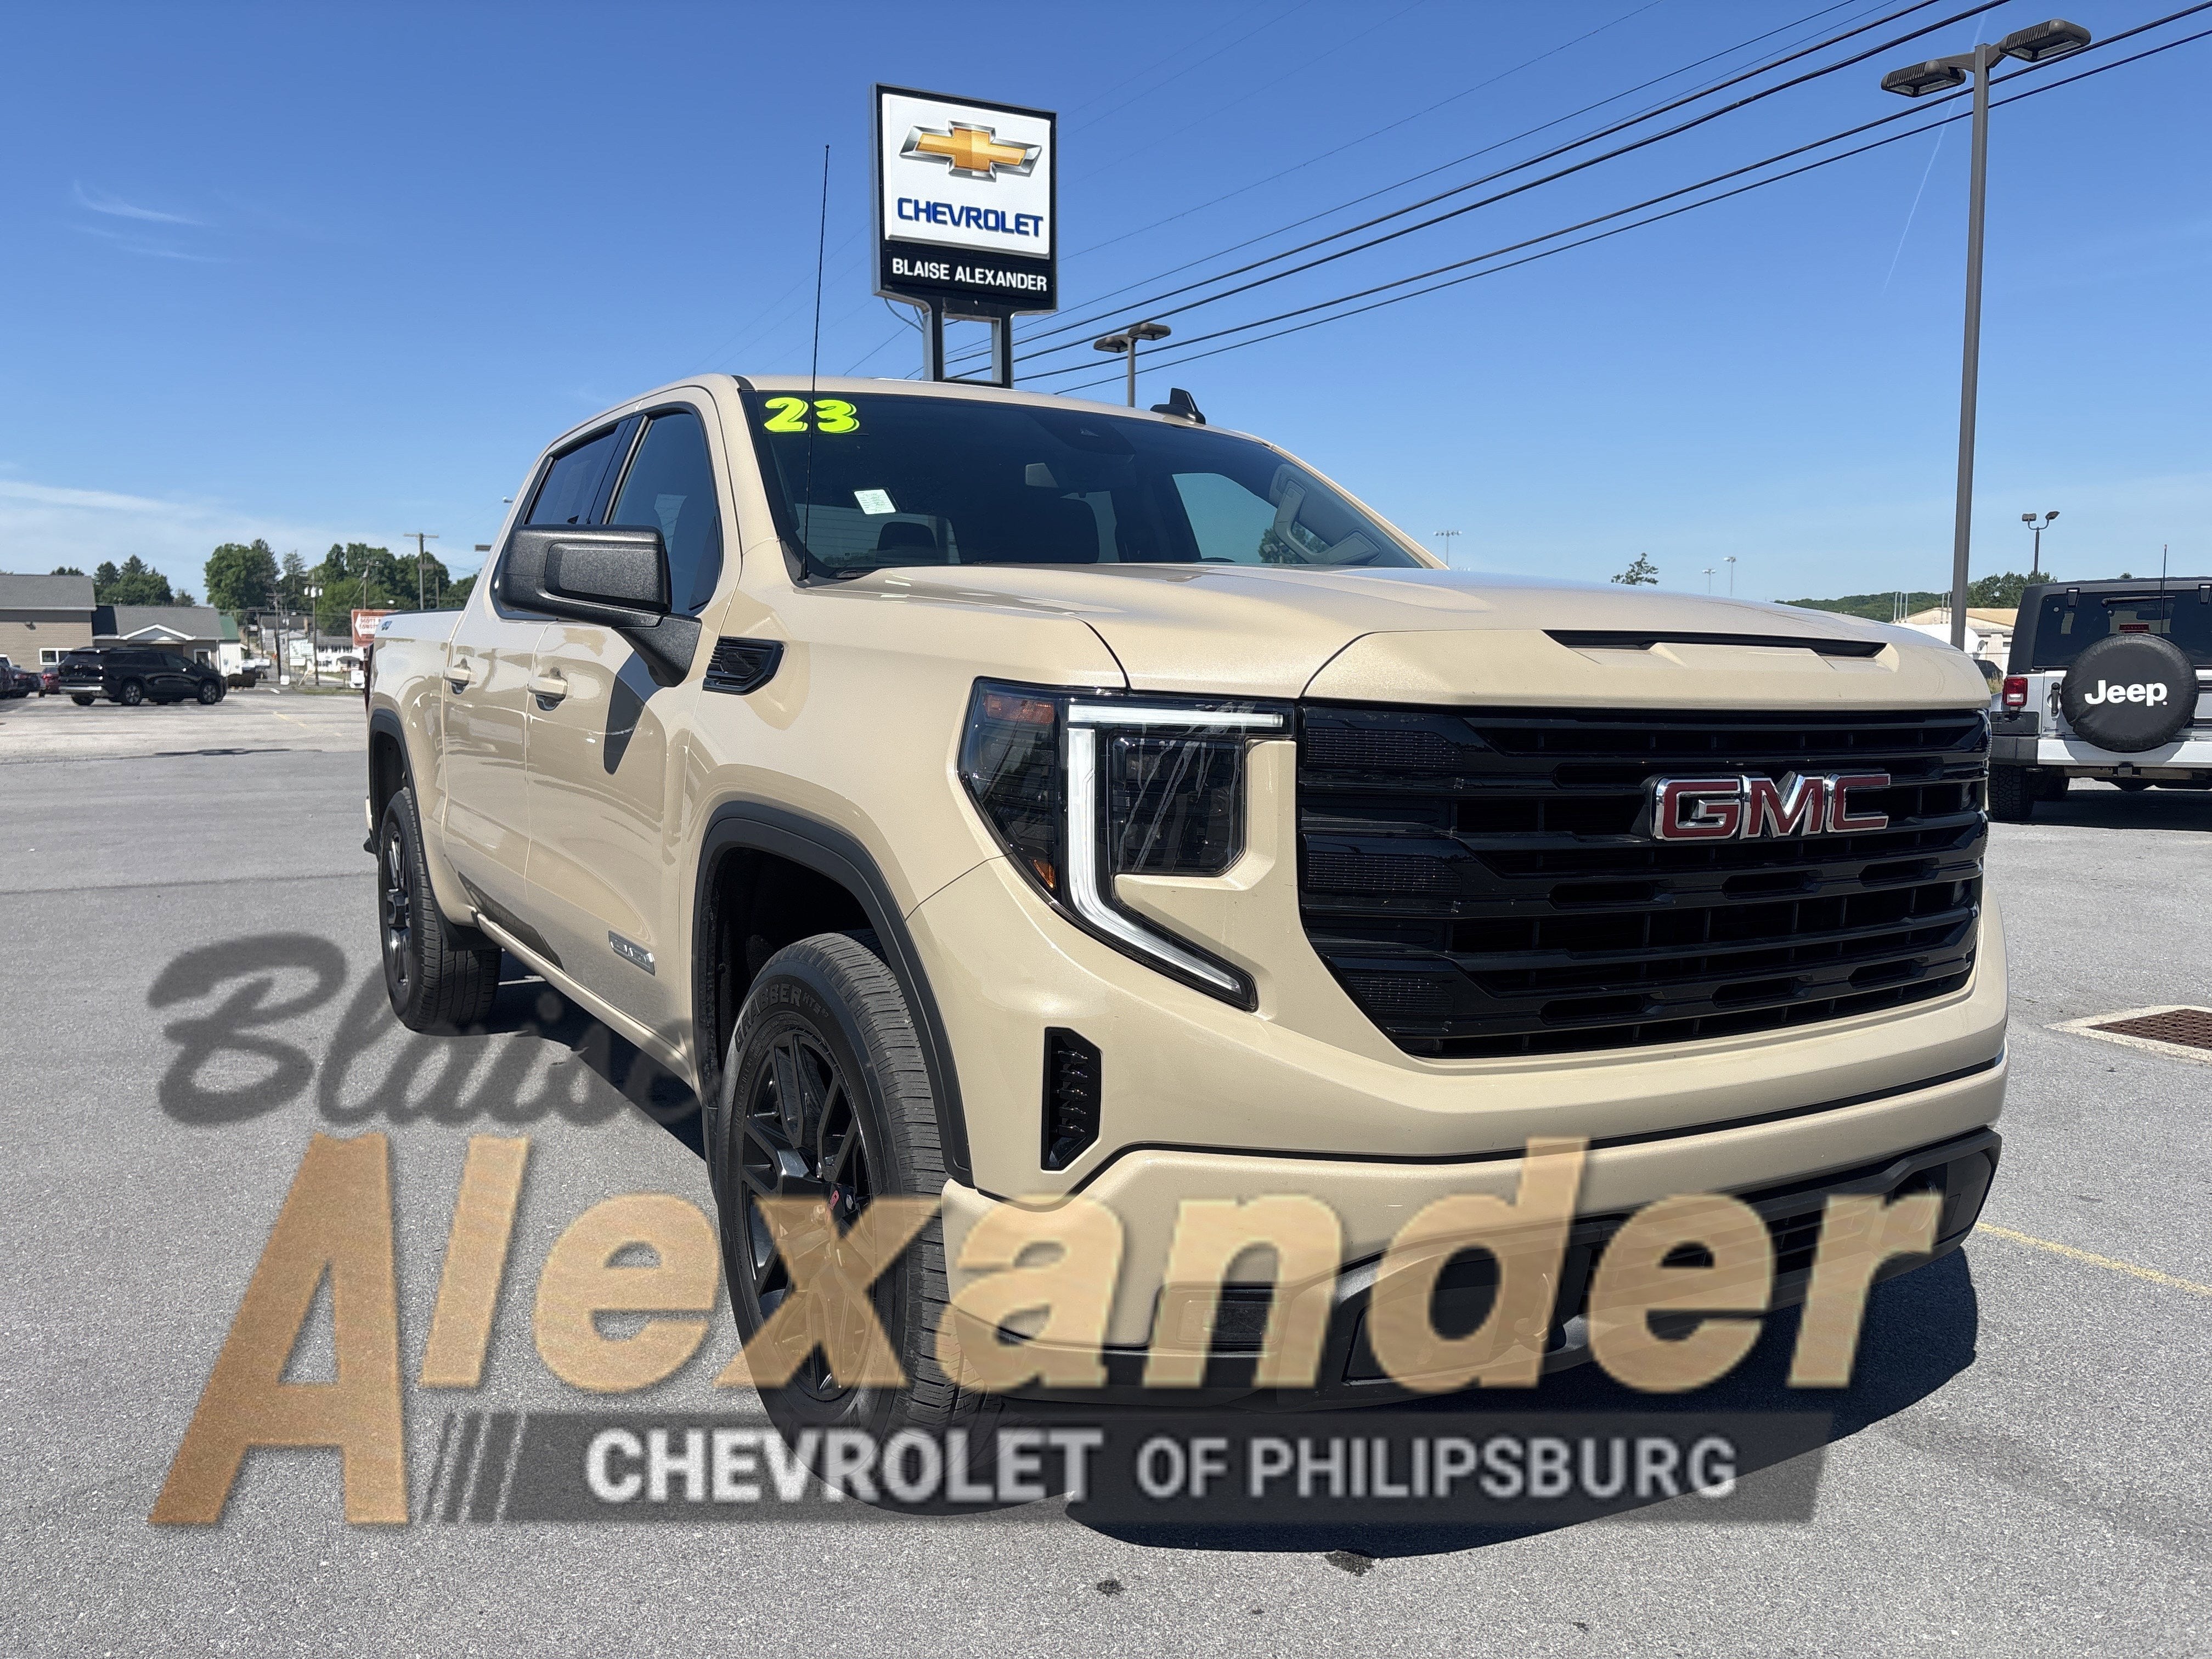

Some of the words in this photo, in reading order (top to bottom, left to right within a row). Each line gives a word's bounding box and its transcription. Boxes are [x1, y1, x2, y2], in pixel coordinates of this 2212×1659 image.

[897, 196, 1044, 238] CHEVROLET
[892, 258, 950, 280] BLAISE
[954, 265, 1048, 292] ALEXANDER
[763, 397, 861, 434] 23
[2084, 680, 2168, 707] Jeep
[1650, 772, 1891, 841] GMC
[734, 984, 802, 1053] GRABBER
